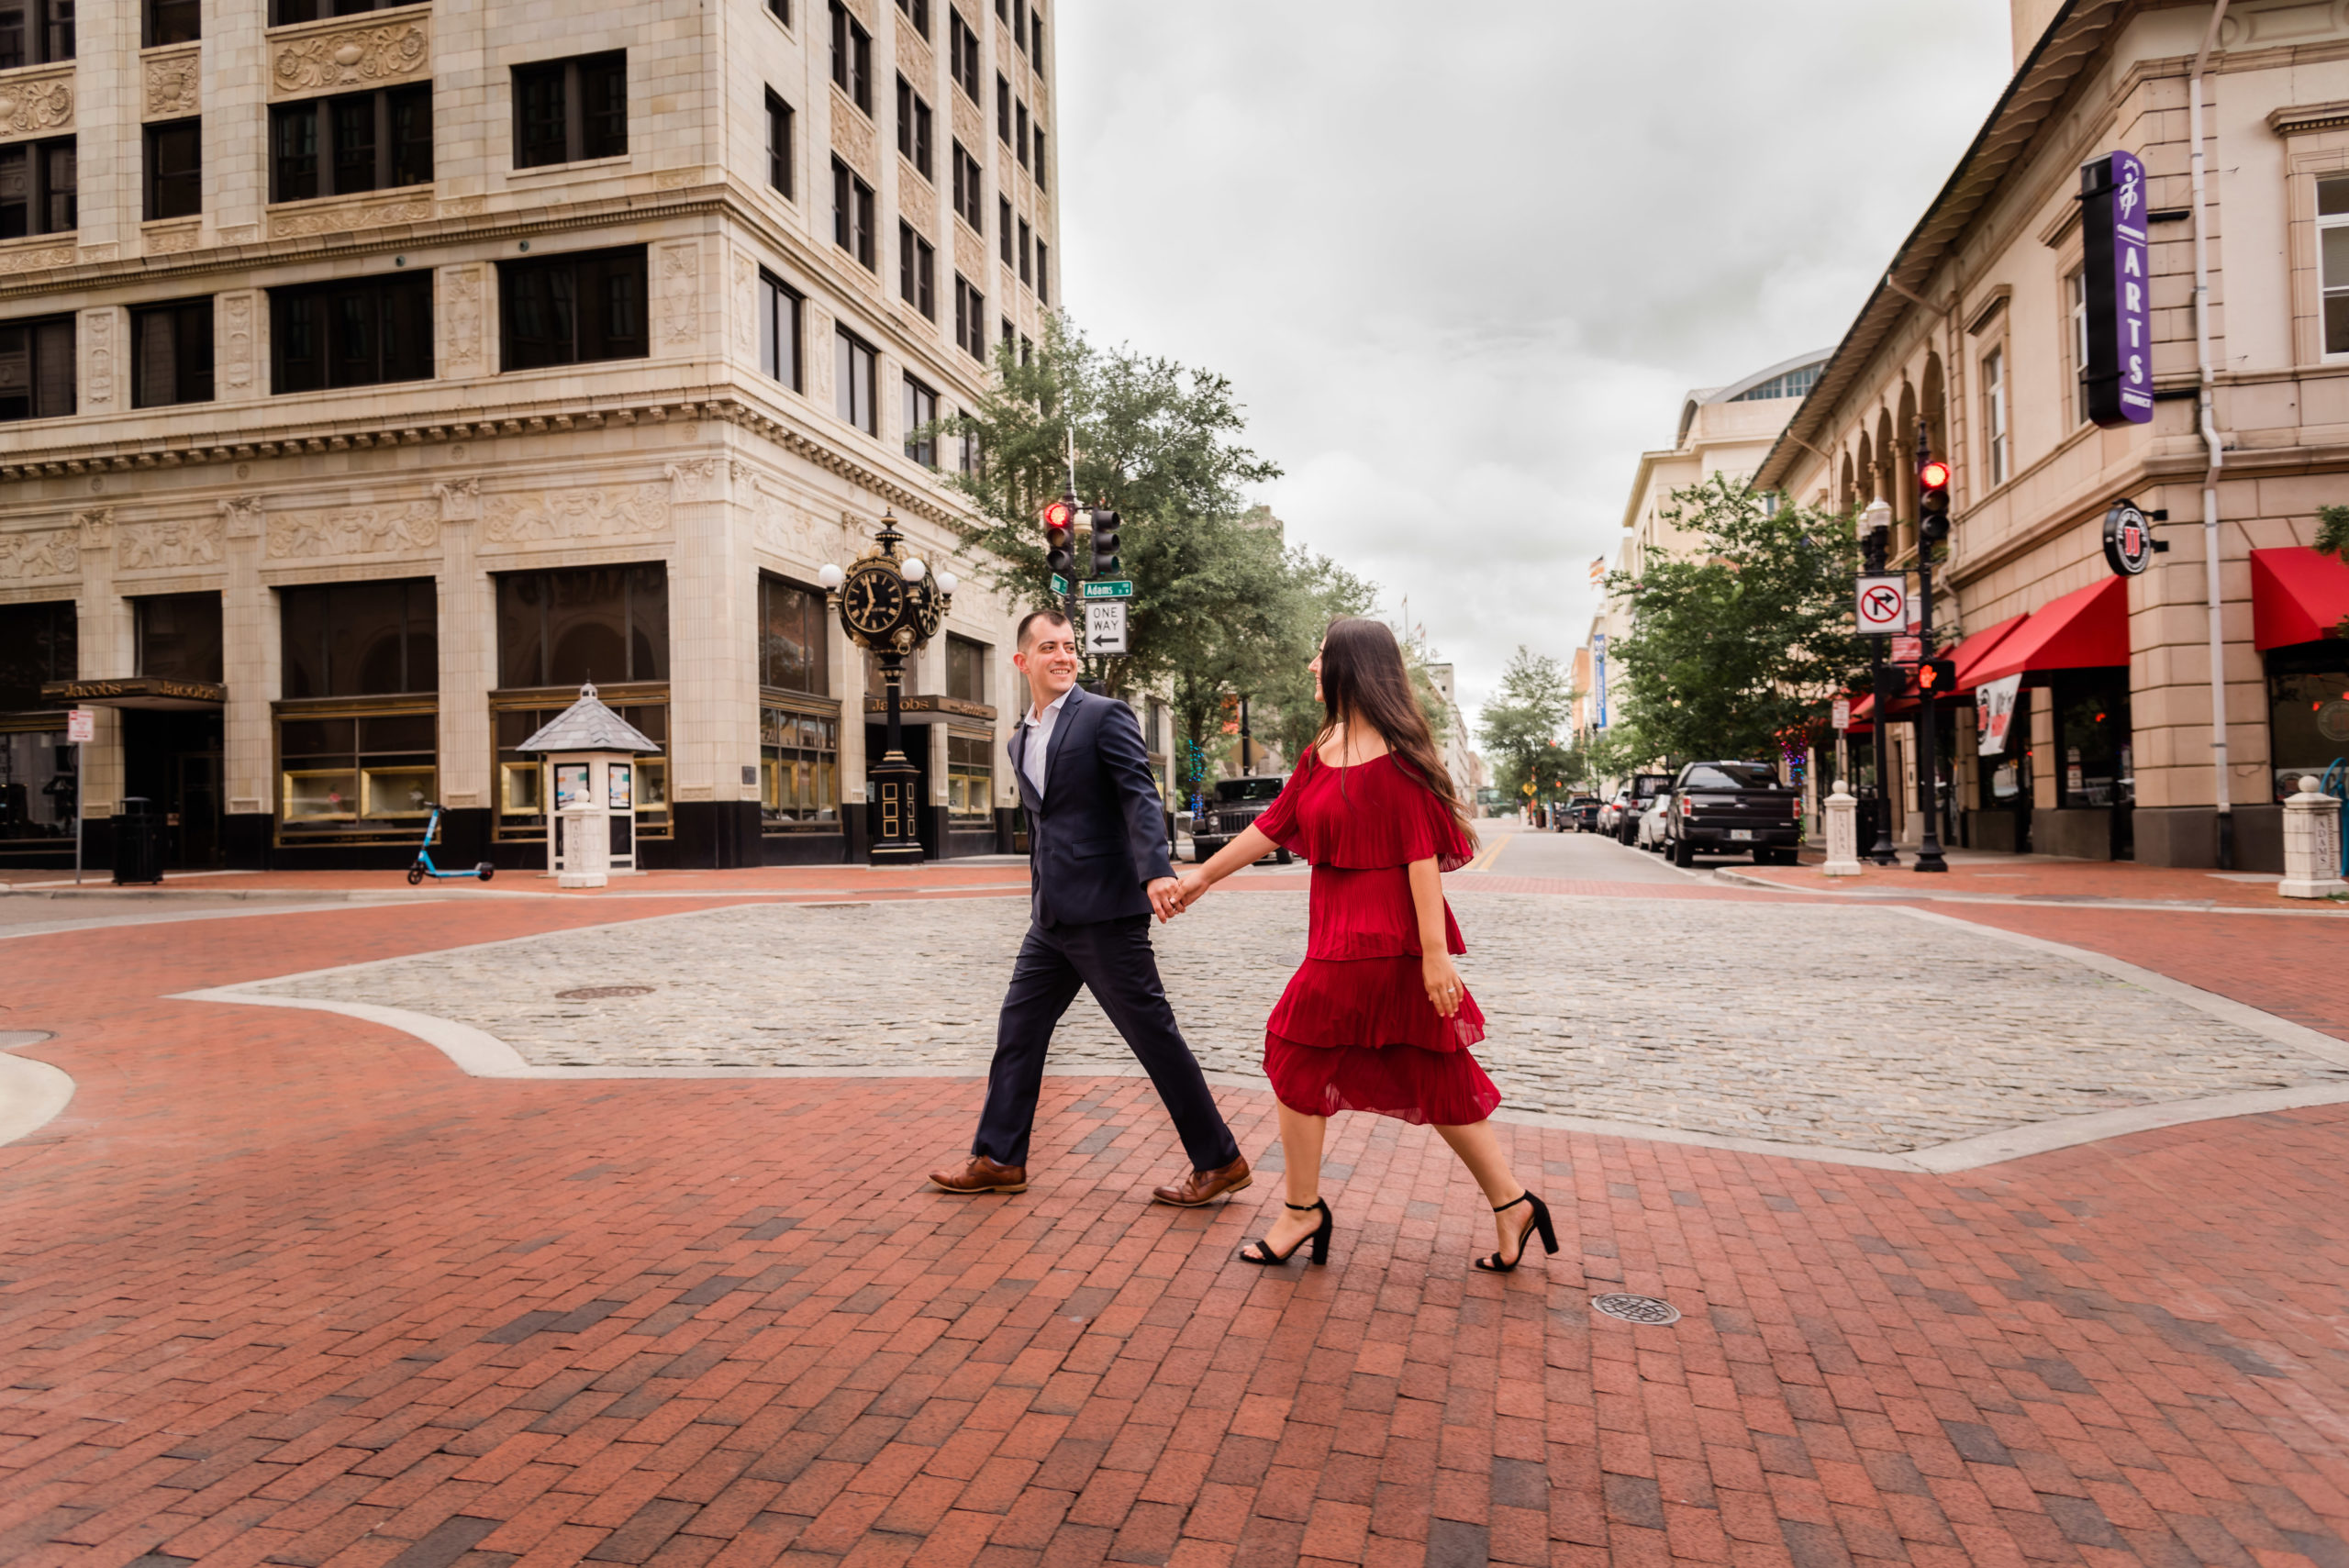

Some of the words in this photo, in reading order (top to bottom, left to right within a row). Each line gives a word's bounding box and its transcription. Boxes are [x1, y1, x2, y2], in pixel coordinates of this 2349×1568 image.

[2123, 246, 2143, 385] ARTS
[1086, 584, 1113, 595] Adams
[1093, 606, 1119, 618] ONE
[1093, 620, 1119, 631] WAY
[65, 682, 122, 697] Jacobs
[160, 680, 218, 700] Jacobs
[873, 697, 930, 712] Jaobs
[572, 825, 580, 862] ADAMS
[2318, 820, 2328, 864] ADAMS
